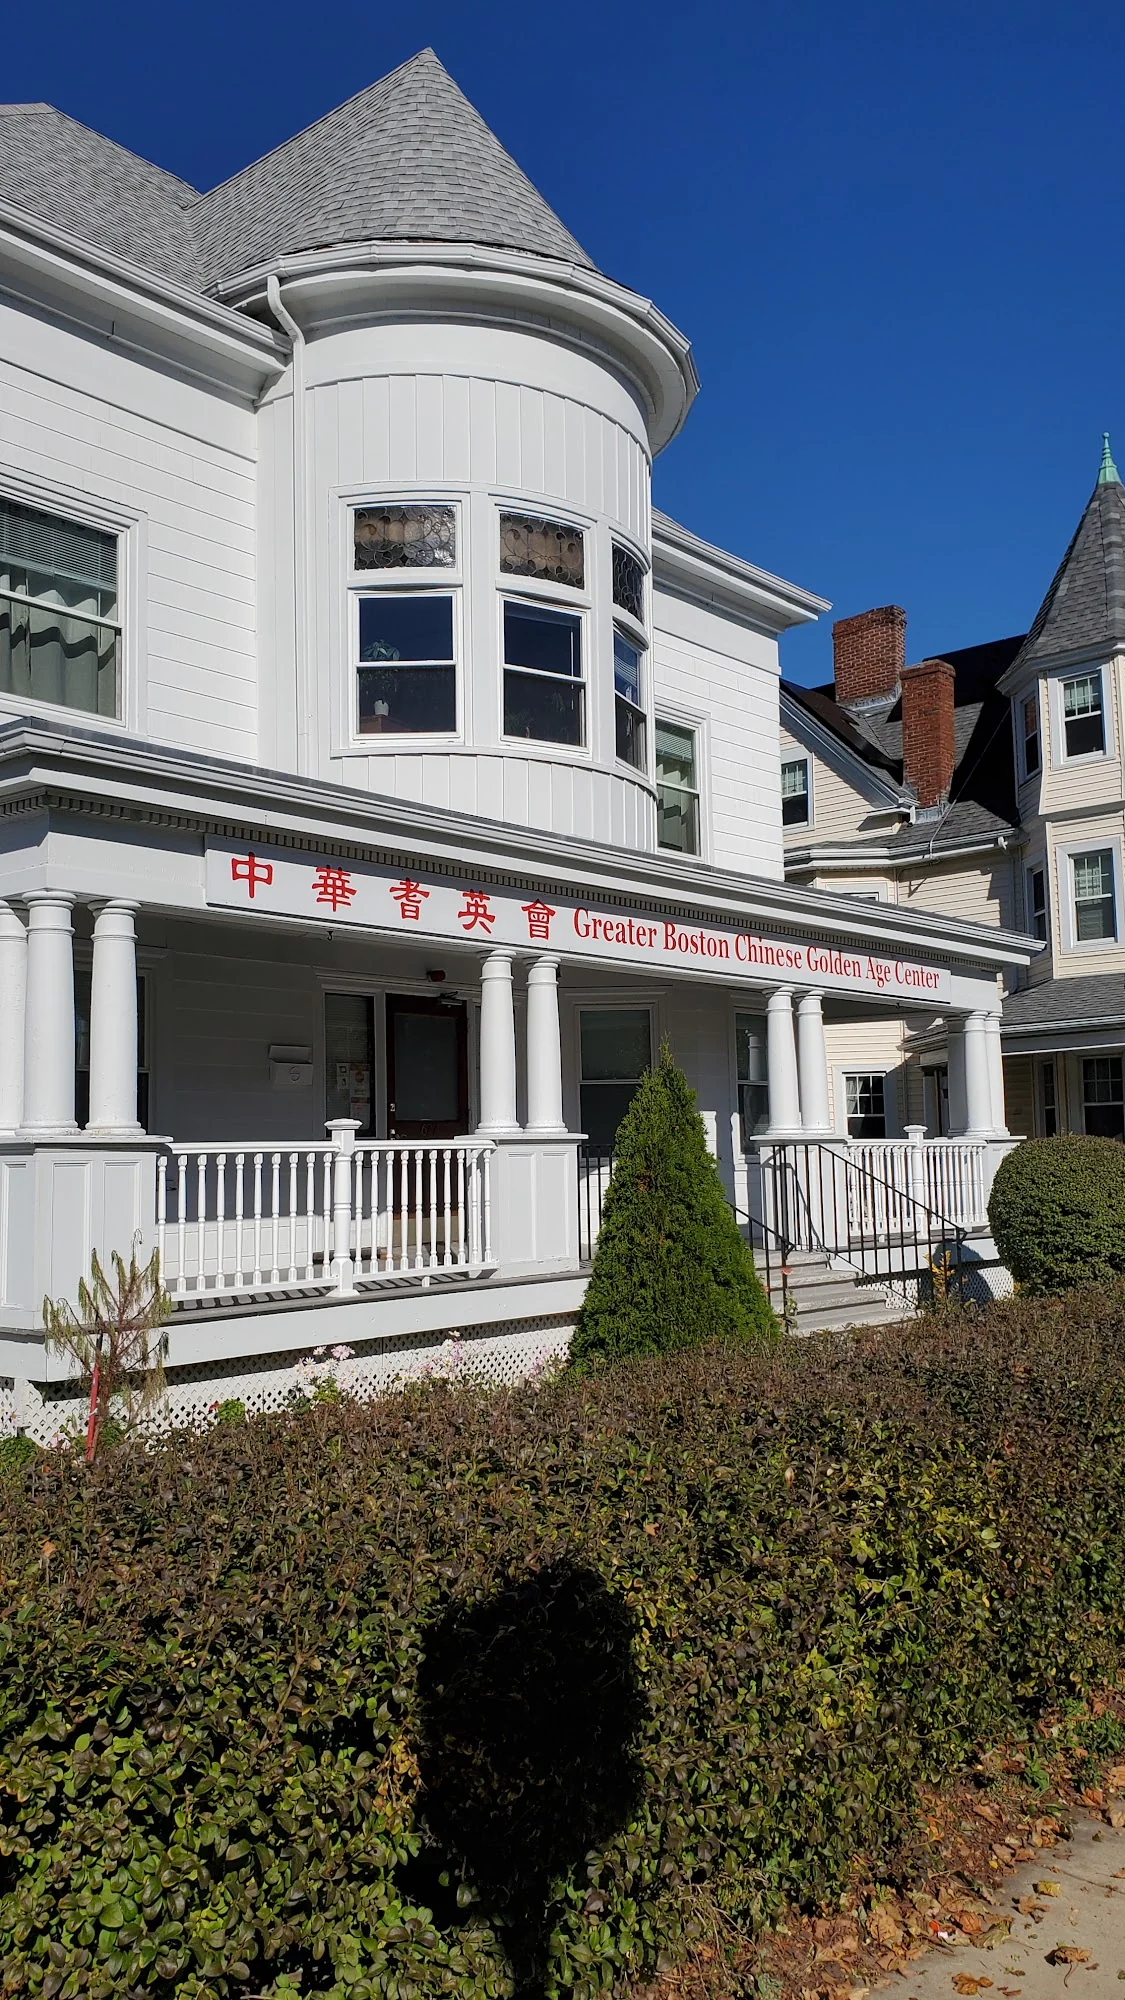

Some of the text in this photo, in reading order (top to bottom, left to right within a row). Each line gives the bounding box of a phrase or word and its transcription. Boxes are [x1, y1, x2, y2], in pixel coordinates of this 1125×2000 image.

[231, 851, 556, 940] 中華耆英會
[574, 908, 940, 989] Greater Boston Chinese Golden Age Center
